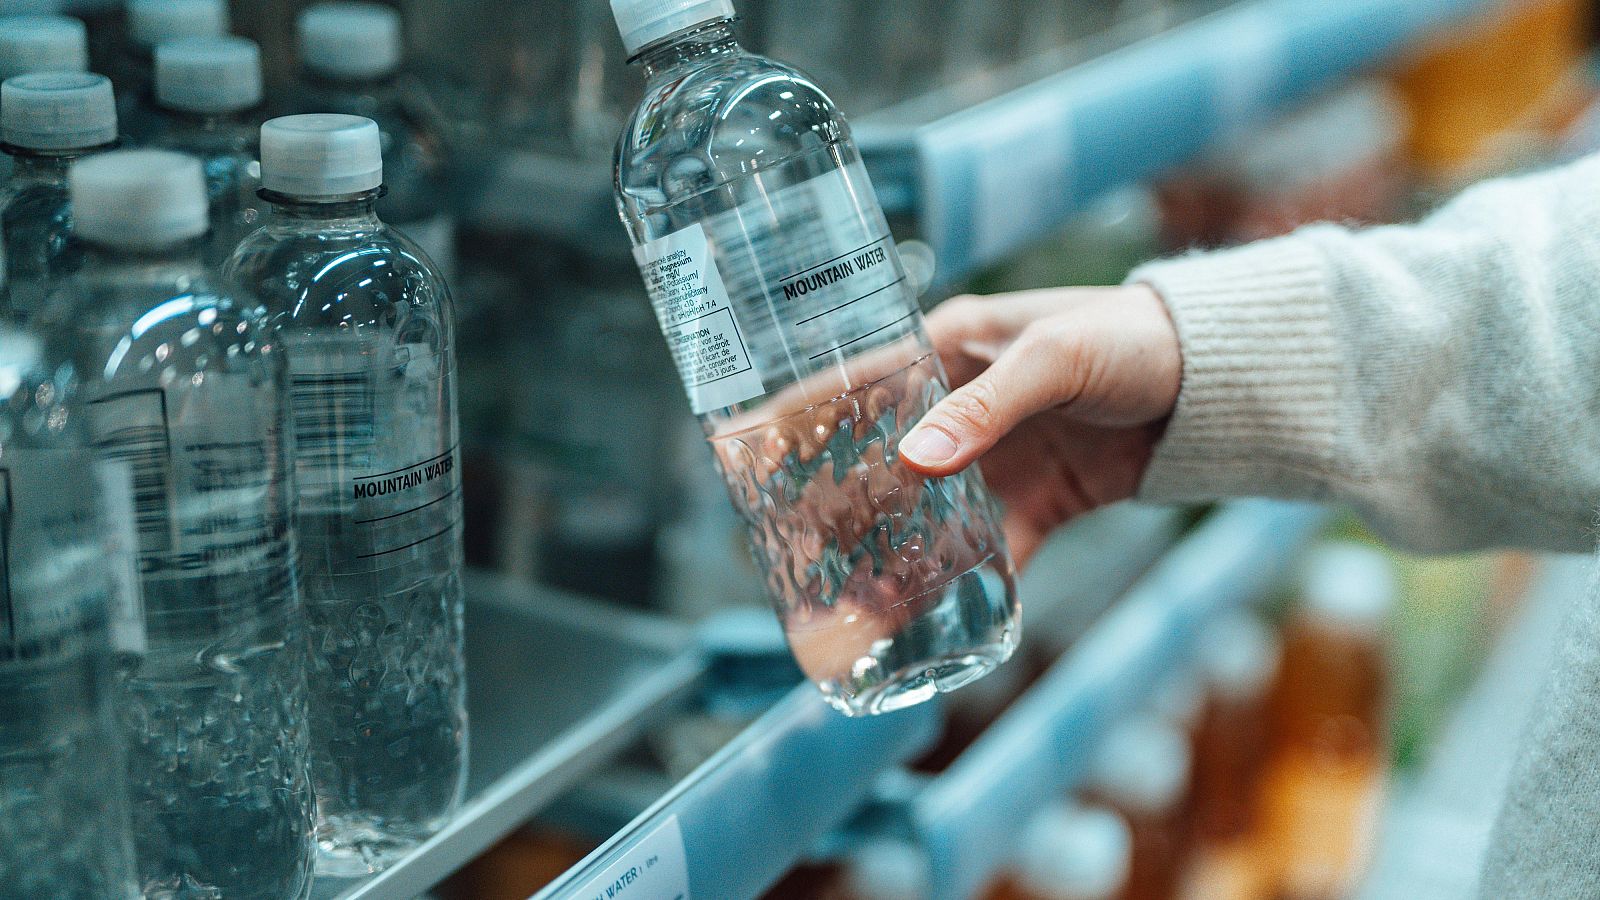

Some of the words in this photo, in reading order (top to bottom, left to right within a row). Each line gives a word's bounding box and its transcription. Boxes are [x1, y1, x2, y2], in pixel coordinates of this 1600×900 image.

[660, 256, 692, 273] Magnesium
[783, 261, 854, 300] MOUNTAIN
[853, 247, 886, 272] WATER
[708, 337, 731, 353] endroit
[713, 332, 724, 342] sur
[721, 347, 730, 357] de
[708, 354, 737, 370] conserver
[721, 364, 738, 376] jours.
[354, 470, 422, 499] MOUNTAIN
[606, 867, 639, 899] WATER
